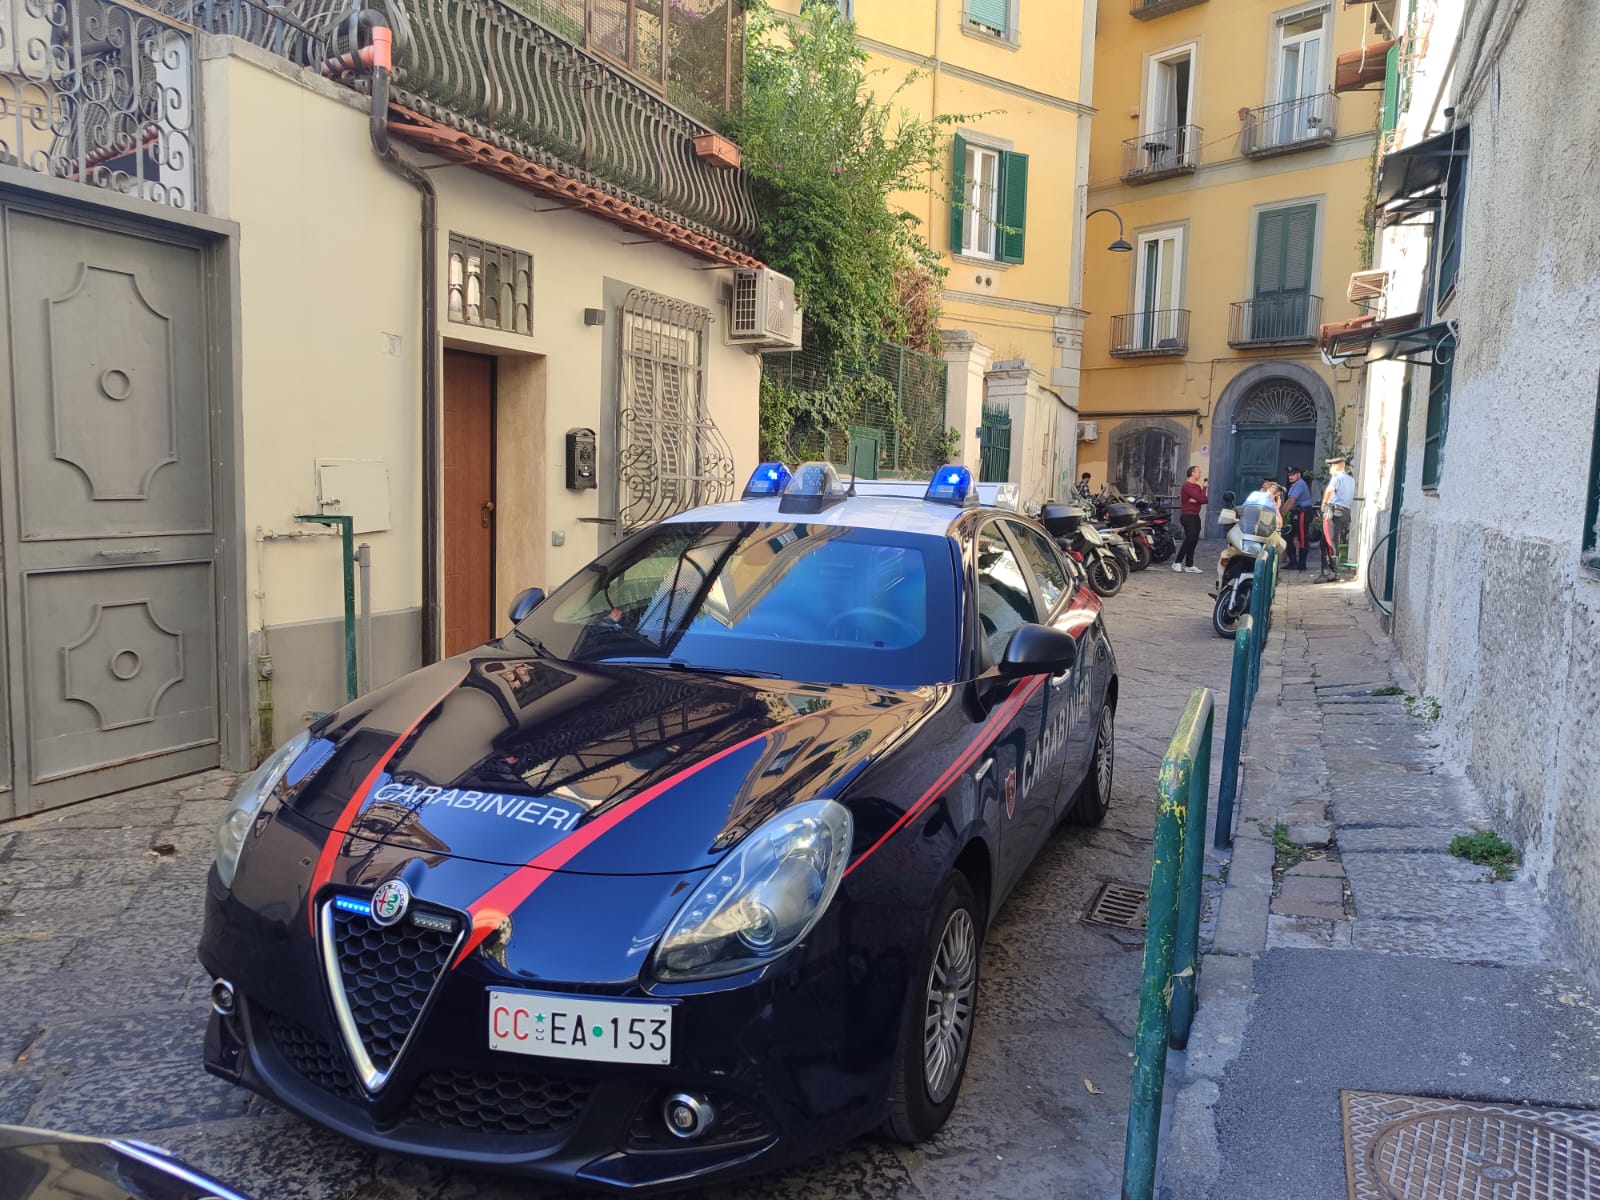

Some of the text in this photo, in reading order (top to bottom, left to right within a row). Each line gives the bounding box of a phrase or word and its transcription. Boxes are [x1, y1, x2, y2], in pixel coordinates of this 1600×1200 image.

[1022, 669, 1092, 799] CARABINIERI
[374, 783, 581, 831] CARABINIERI
[493, 1006, 667, 1051] CC EA 153
